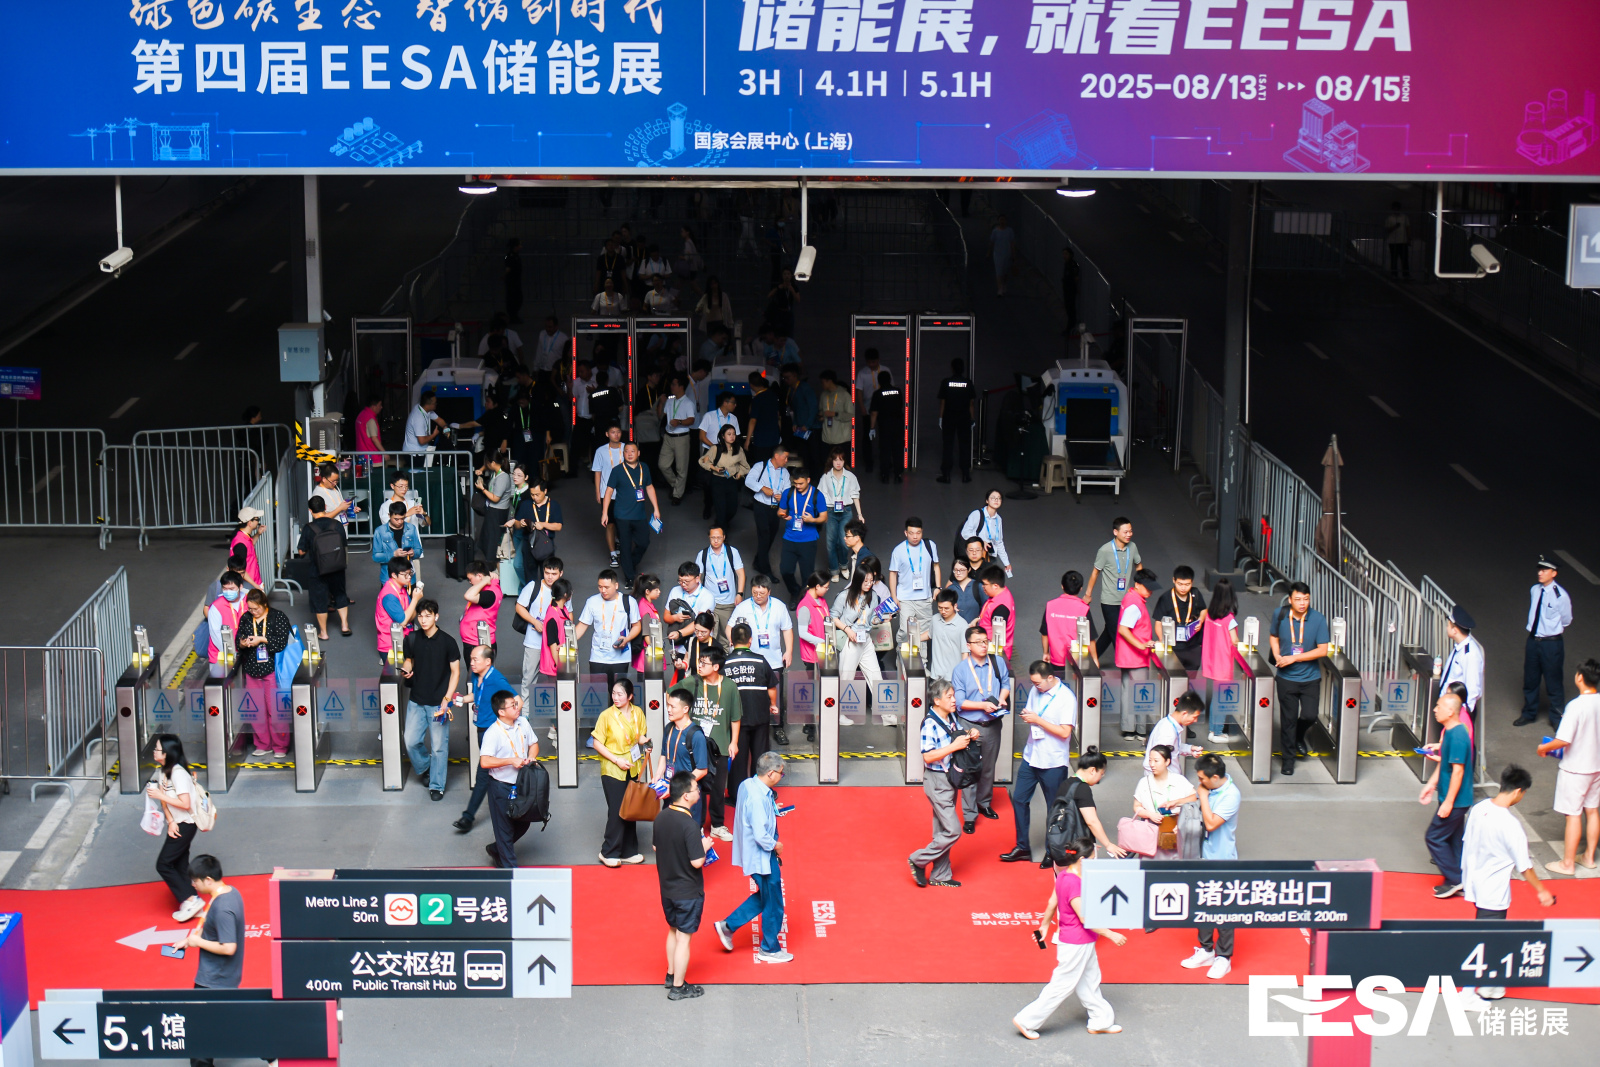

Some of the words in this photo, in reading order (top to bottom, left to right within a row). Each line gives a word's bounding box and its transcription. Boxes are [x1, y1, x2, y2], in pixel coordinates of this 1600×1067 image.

[131, 39, 662, 95] 第四届EESA储能展
[738, 69, 780, 96] 3H
[815, 71, 887, 97] 4.1H
[919, 71, 991, 98] 5.1H
[1080, 74, 1256, 99] 2025-08/13
[1315, 75, 1400, 102] 08/15
[305, 896, 340, 908] Metro
[342, 896, 368, 908] Line
[370, 896, 379, 908] 2
[1195, 879, 1332, 906] 诸光路出口
[353, 911, 379, 923] 50m
[427, 898, 445, 922] 2
[453, 897, 509, 923] 号线
[1194, 911, 1253, 925] Zhuguang
[1254, 911, 1287, 922] Road
[1287, 910, 1312, 922] Exit
[1314, 911, 1348, 922] 200m
[350, 951, 457, 977] 公交枢纽
[1460, 943, 1514, 979] 4.1
[1520, 940, 1547, 966] 馆
[1518, 965, 1543, 978] Hall
[305, 980, 342, 991] 400m
[353, 980, 389, 991] Public
[390, 980, 430, 991] Transit
[433, 980, 457, 991] Hub
[103, 1016, 154, 1052] 5.1
[160, 1013, 186, 1038] 馆
[161, 1038, 185, 1050] Hall
